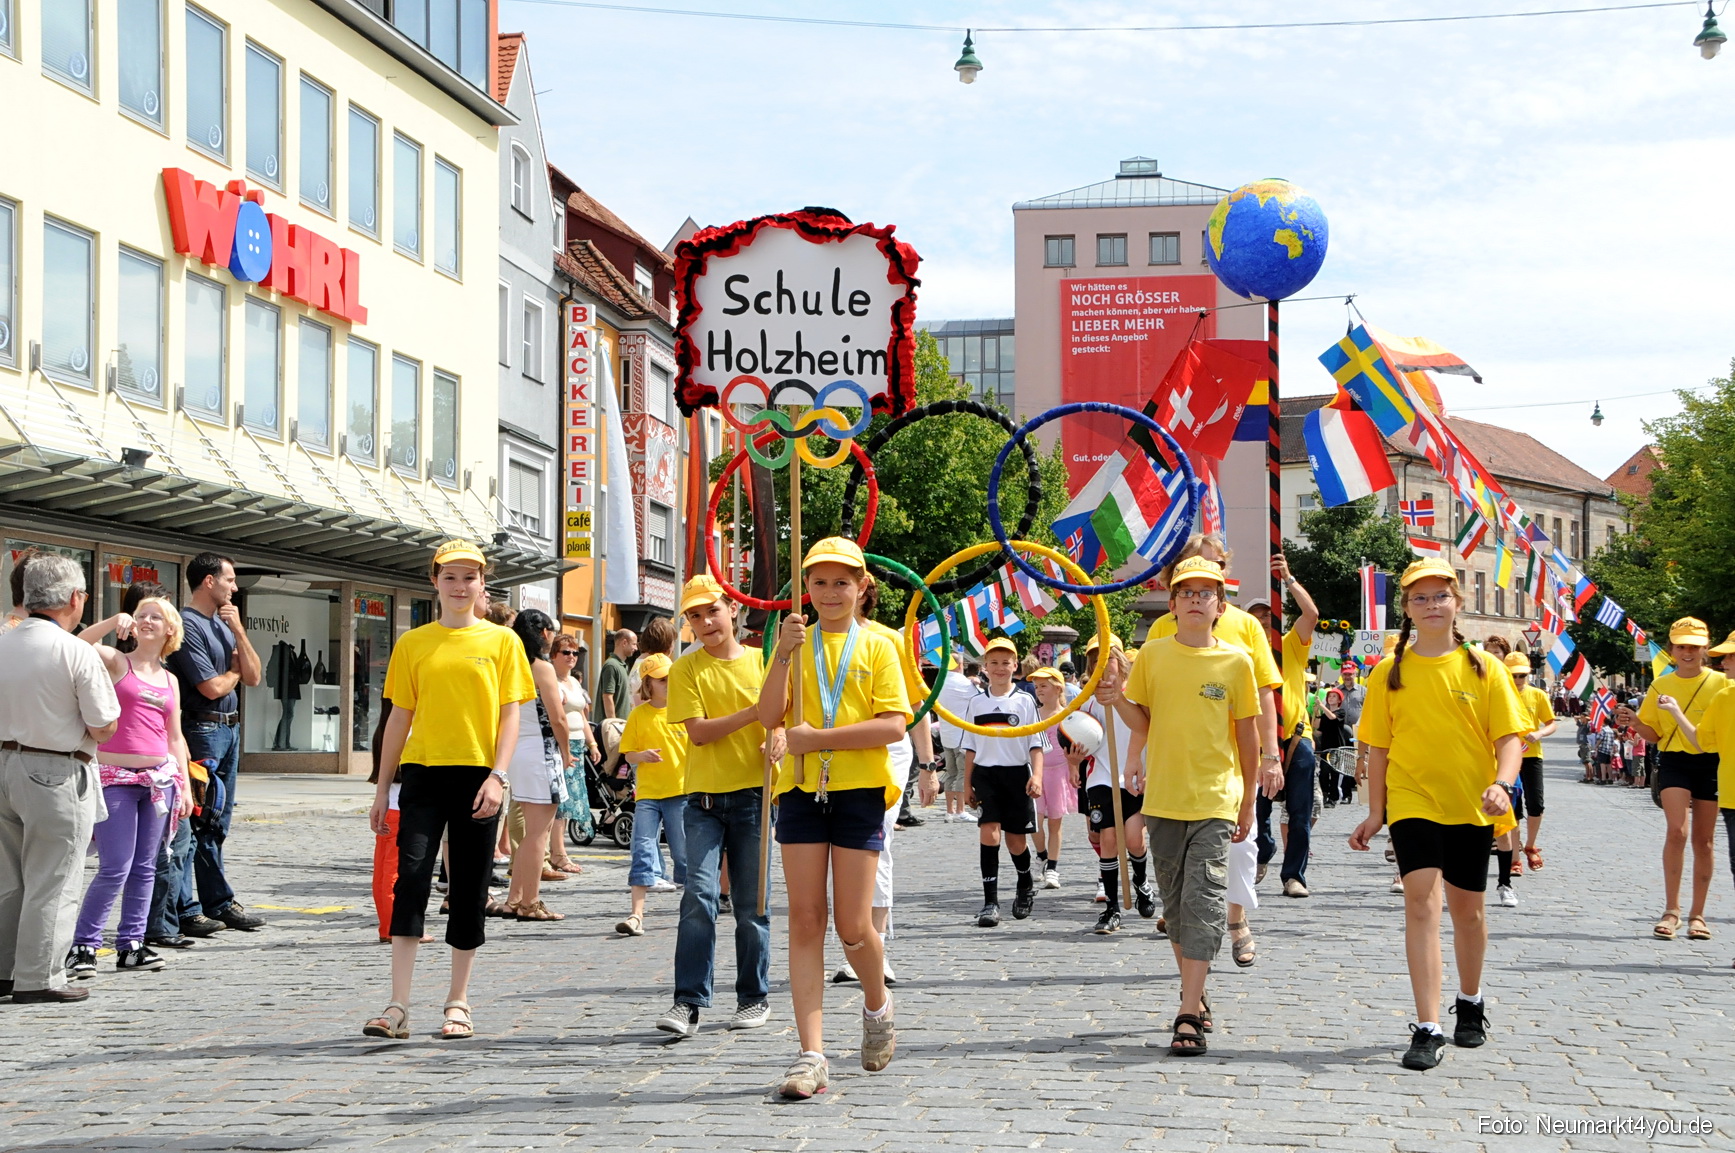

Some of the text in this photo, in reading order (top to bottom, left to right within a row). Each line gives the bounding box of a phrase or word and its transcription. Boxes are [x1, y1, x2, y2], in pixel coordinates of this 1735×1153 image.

[162, 167, 368, 325] WÖHRL
[722, 267, 871, 316] Schule
[1071, 284, 1086, 292] Wir
[1088, 283, 1116, 291] hätten
[1071, 290, 1180, 306] NOCH GRÖSSER
[1071, 308, 1105, 317] machen
[1106, 308, 1141, 316] können,
[1164, 306, 1177, 314] wir
[1072, 318, 1165, 332] LIEBER MEHR
[1082, 334, 1110, 342] dieses
[1111, 333, 1149, 343] Angebot
[708, 329, 888, 375] Holzheim
[1072, 345, 1111, 355] gesteckt:
[571, 306, 588, 504] BÄCKEREI
[1072, 453, 1090, 462] Gut,
[567, 513, 591, 528] café
[566, 541, 591, 554] plank
[1361, 631, 1379, 640] Die
[1364, 643, 1383, 655] Oly
